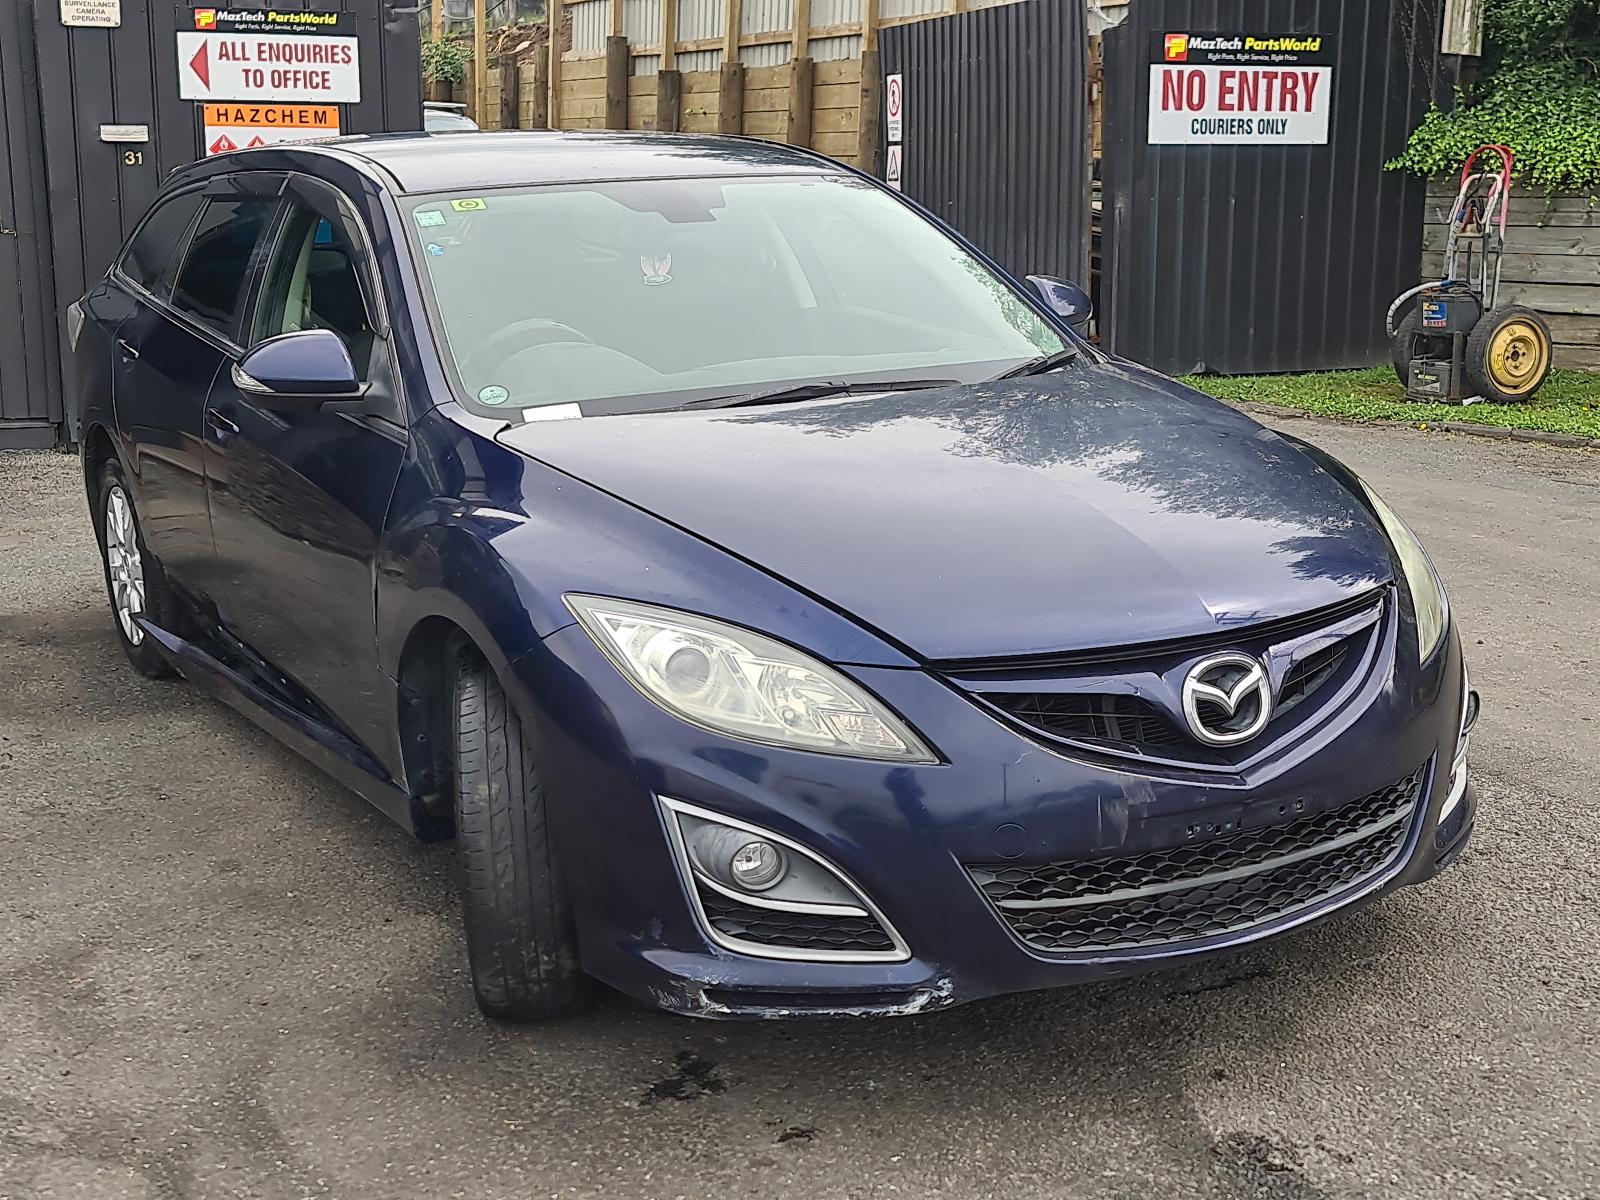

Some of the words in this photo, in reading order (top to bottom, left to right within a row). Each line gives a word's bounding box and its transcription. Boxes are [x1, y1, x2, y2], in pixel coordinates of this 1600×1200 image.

[267, 12, 338, 25] PartsWorld
[218, 41, 251, 61] ALL
[257, 42, 352, 65] ENQUIRIES
[1188, 37, 1242, 50] MazTech
[1244, 37, 1322, 52] PartsWorld
[242, 68, 264, 88] TO
[270, 69, 331, 90] OFFICE
[1161, 69, 1206, 111] NO
[1217, 70, 1319, 113] ENTRY
[216, 108, 328, 125] HAZCHEM
[1191, 118, 1253, 135] COURIERS
[1257, 119, 1288, 135] ONLY
[124, 150, 143, 165] 31
